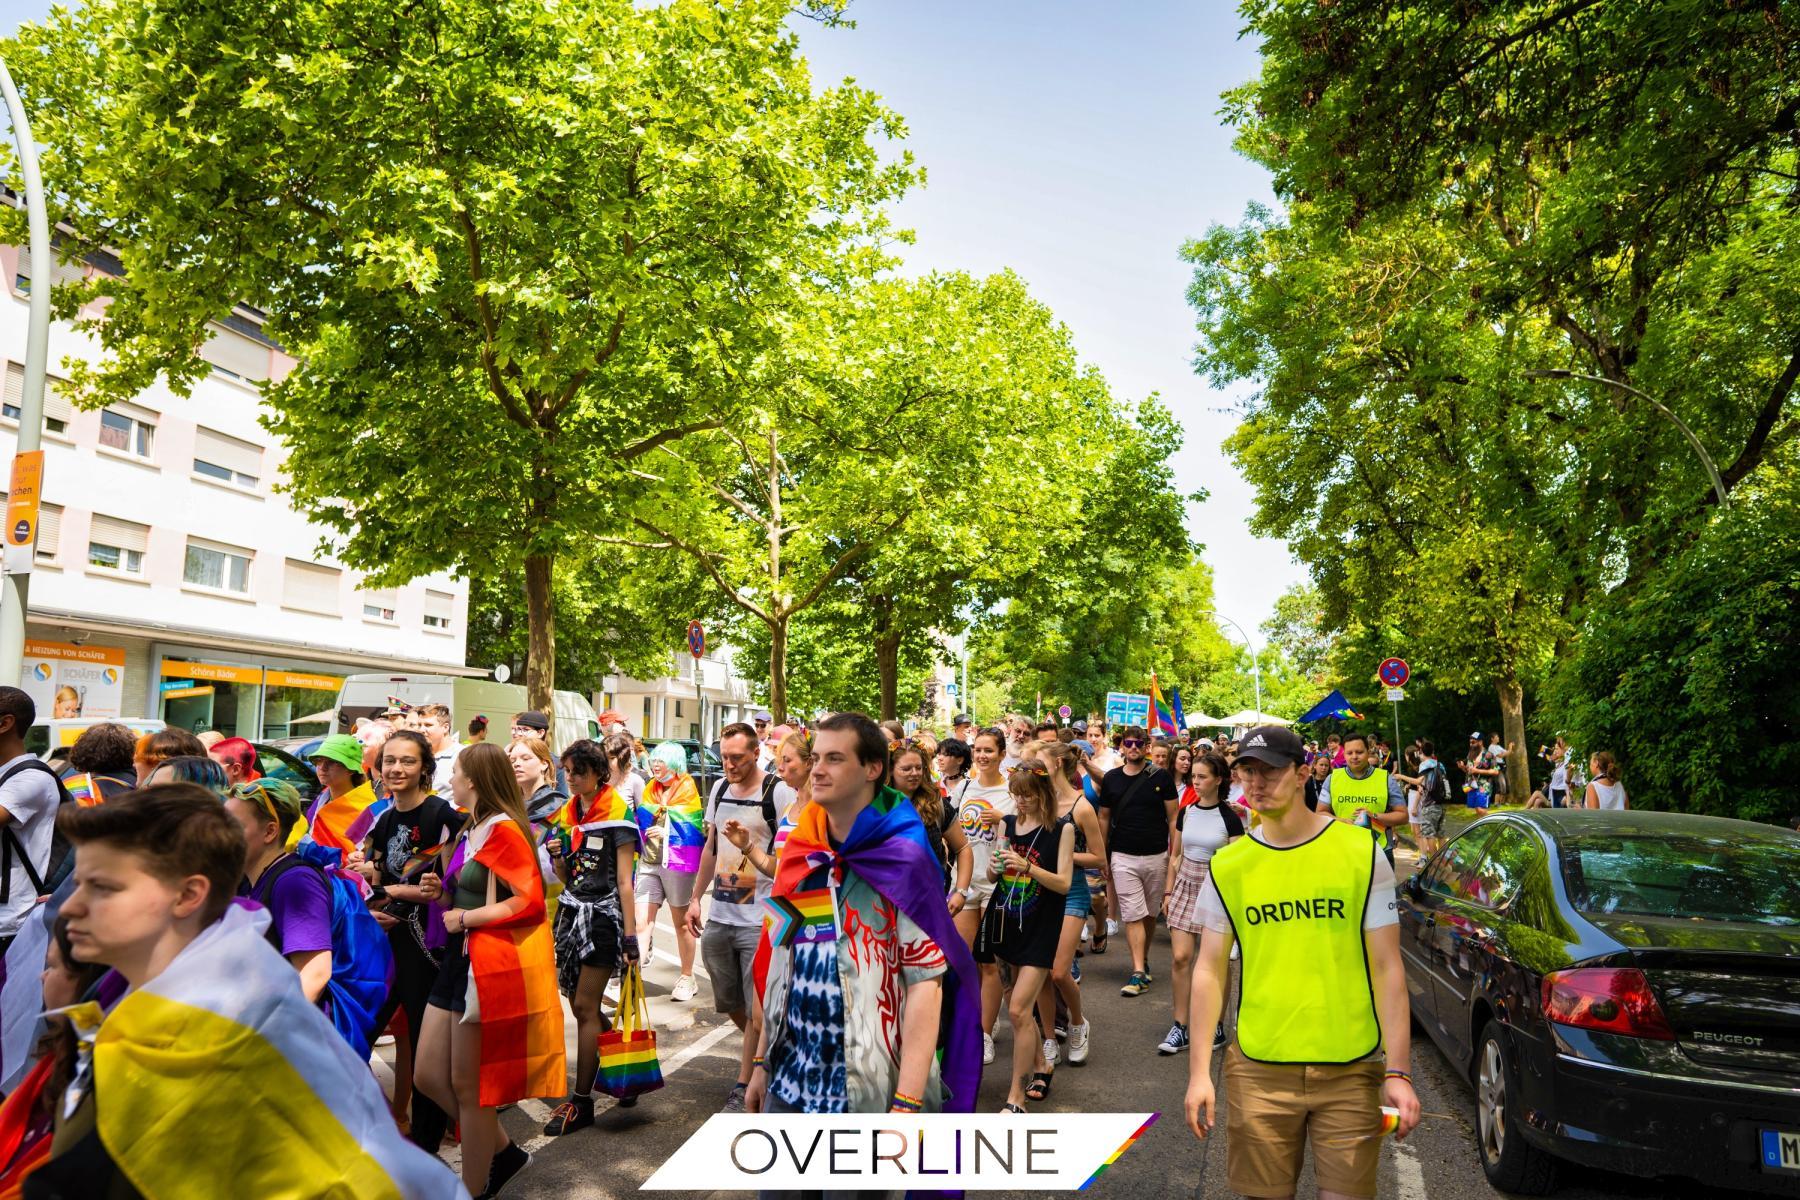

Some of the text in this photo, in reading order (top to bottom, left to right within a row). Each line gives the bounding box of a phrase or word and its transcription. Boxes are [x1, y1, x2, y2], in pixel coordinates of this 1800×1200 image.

[32, 647, 61, 656] HEIZUNG
[63, 649, 77, 657] VON
[78, 651, 105, 660] SCHÄFER
[63, 667, 101, 680] SCHÄFER
[190, 666, 237, 679] Schöne Bäder
[286, 676, 312, 686] Moderne
[1337, 795, 1378, 804] ORDNER
[1245, 898, 1345, 926] ORDNER
[1693, 1031, 1764, 1046] PEUGEOT
